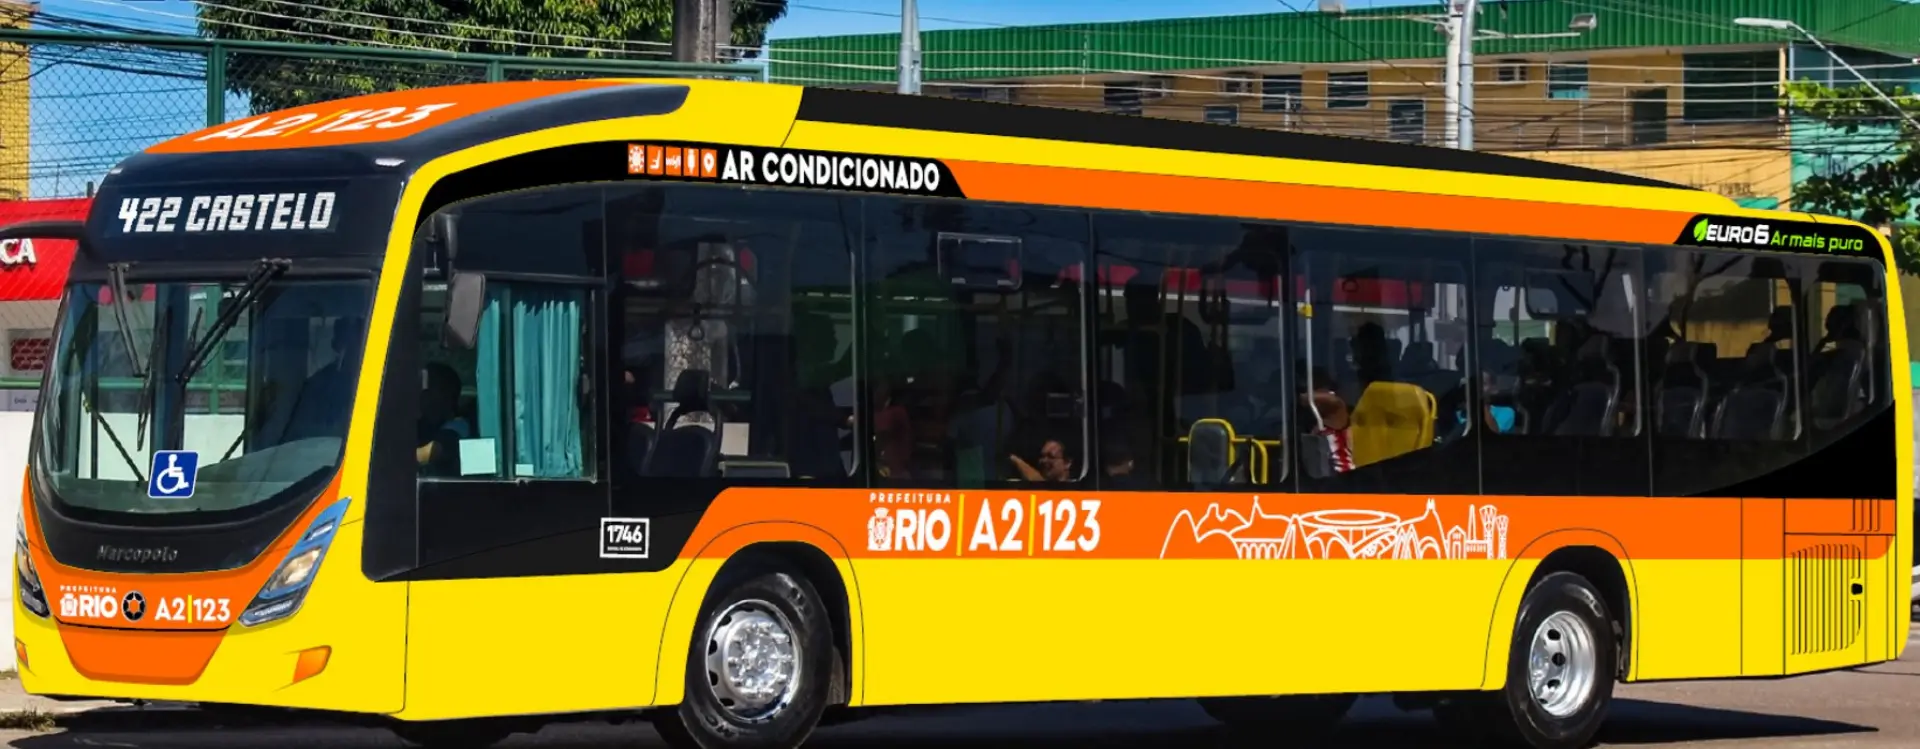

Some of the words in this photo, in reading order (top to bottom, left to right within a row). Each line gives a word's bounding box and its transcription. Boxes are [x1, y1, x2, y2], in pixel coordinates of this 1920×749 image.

[721, 150, 755, 181] AR
[762, 152, 940, 191] CONDICIONADO
[118, 197, 182, 232] 422
[185, 192, 336, 231] CASTELO
[1770, 231, 1789, 246] Ar
[1790, 232, 1825, 248] mais
[1828, 237, 1864, 252] puro
[869, 492, 951, 504] PREFEITURA
[607, 525, 643, 543] 1746
[895, 509, 951, 551] RIO
[60, 585, 117, 593] PREFEITURA
[79, 594, 118, 618] RIO
